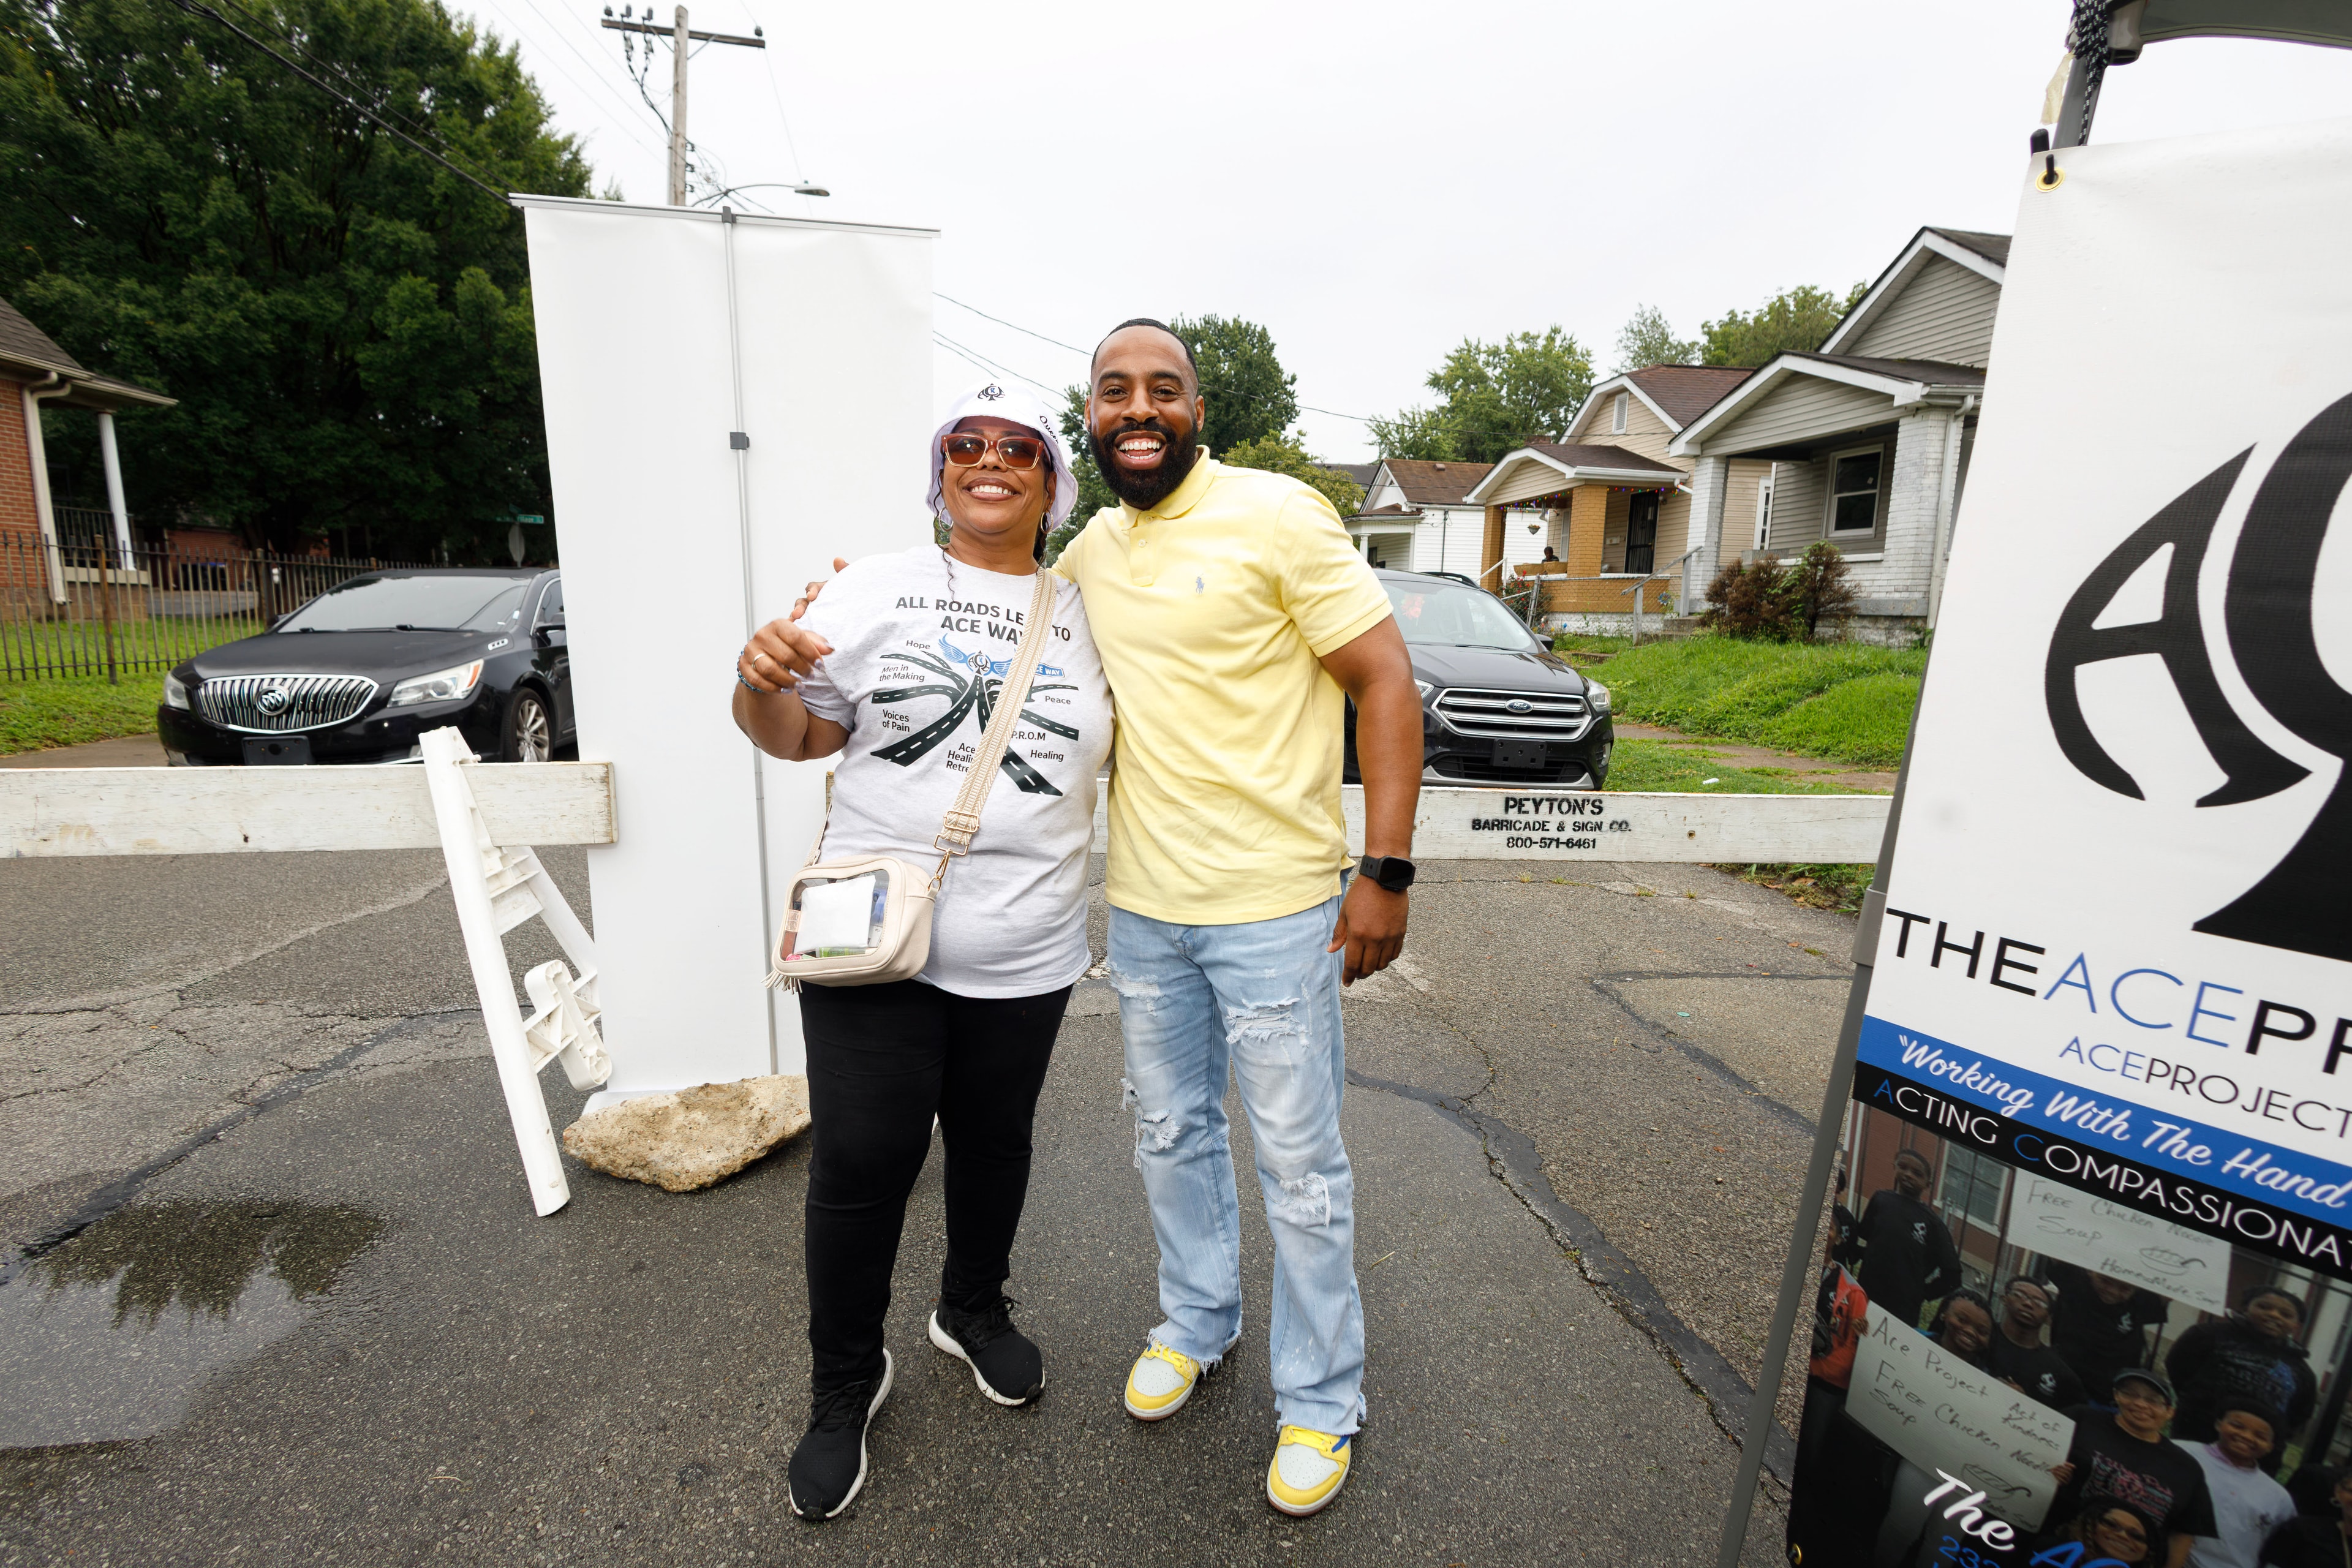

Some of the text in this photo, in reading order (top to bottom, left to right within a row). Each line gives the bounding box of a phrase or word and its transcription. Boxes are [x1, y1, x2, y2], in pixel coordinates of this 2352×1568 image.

[895, 597, 1071, 641] ALL ROADS LE TO
[941, 616, 1023, 646] ACE WA
[906, 640, 930, 649] Hope
[892, 673, 925, 682] Making
[1045, 695, 1071, 705] Peace
[883, 709, 910, 722] Voices
[883, 720, 910, 733] of Pain
[959, 742, 976, 754] Ace
[1030, 750, 1064, 763] Healing
[1504, 797, 1603, 815] PEYTON'S
[1471, 818, 1632, 832] BARRICADE & SIGN CO.
[1506, 837, 1596, 849] 800-571-6461
[2045, 1090, 2132, 1140] With
[2141, 1120, 2212, 1166] The
[1874, 1078, 2352, 1271] ACTING COMPASSIONA
[2035, 1216, 2103, 1246] Soup
[1872, 1316, 1989, 1396] Ace Project
[1868, 1387, 1917, 1427] Soup
[1875, 1359, 1926, 1408] FREE
[1934, 1403, 2001, 1450] Chicken
[2009, 1401, 2060, 1433] Act of
[1924, 1467, 2015, 1551] The
